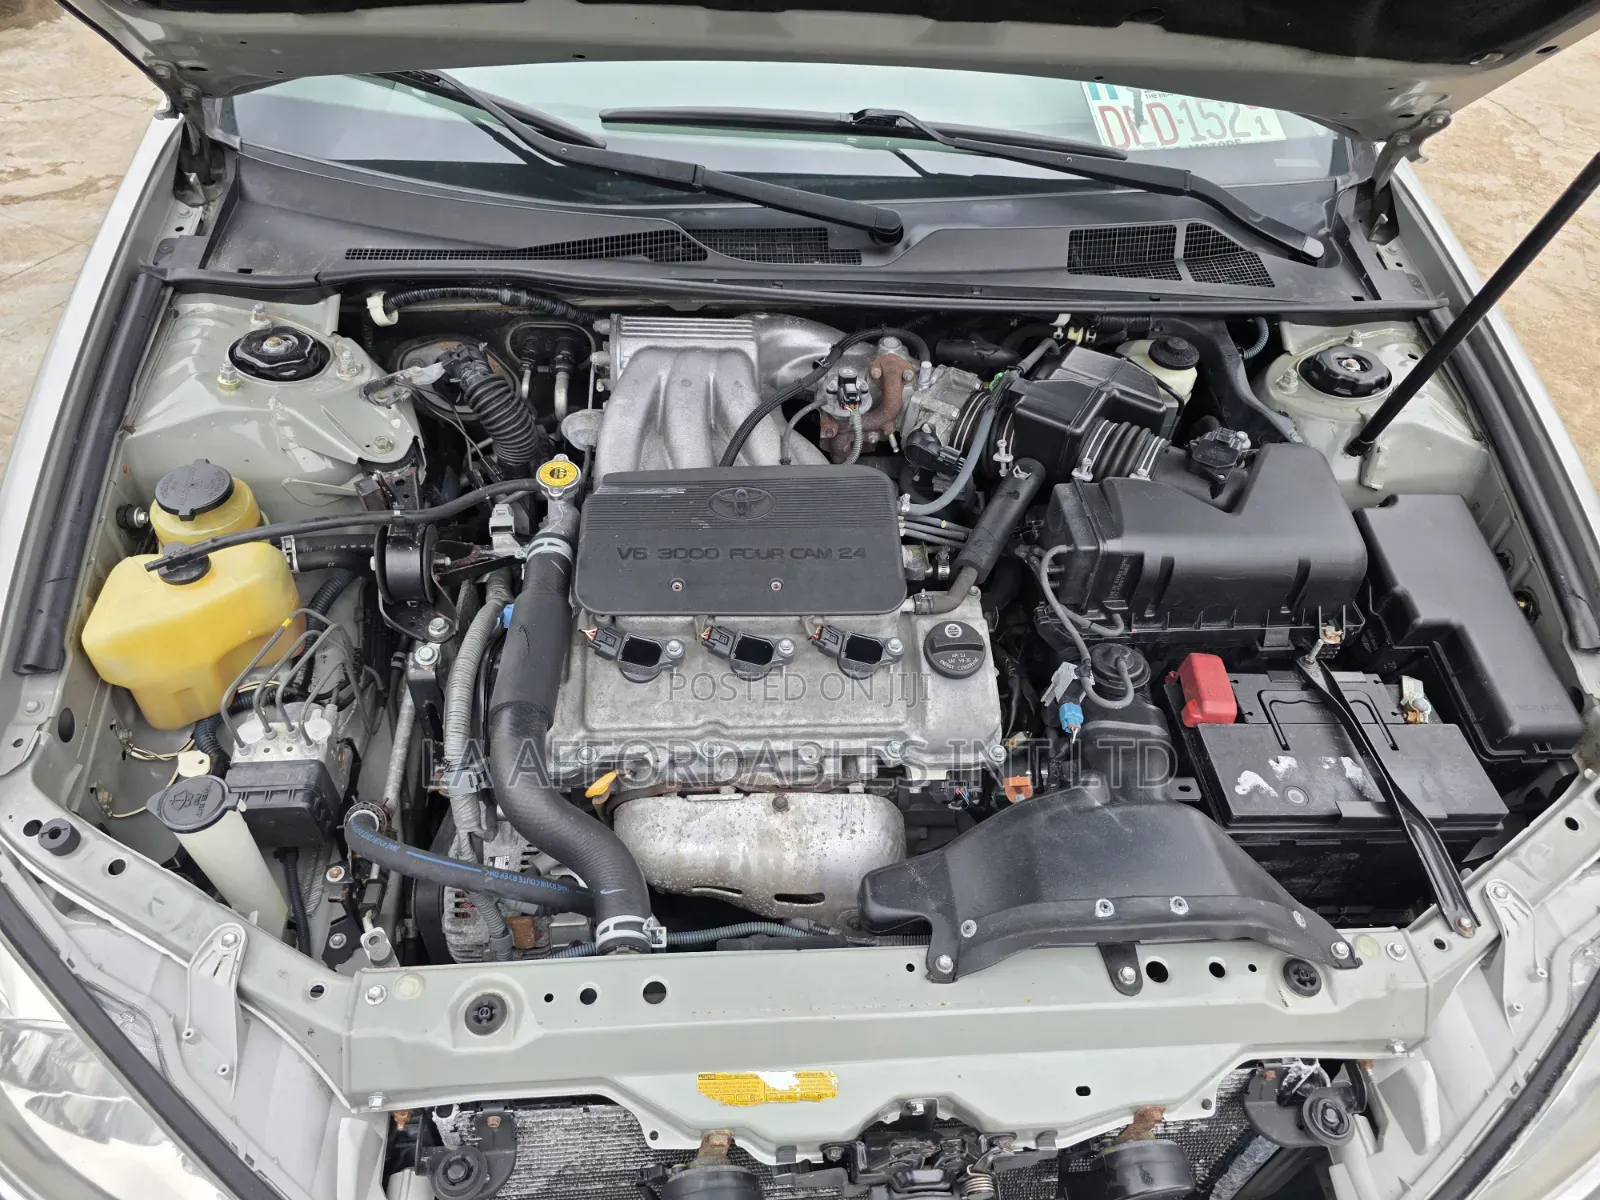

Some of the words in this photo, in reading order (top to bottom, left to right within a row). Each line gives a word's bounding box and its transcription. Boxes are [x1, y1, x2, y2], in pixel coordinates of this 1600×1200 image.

[616, 546, 648, 561] V6
[657, 546, 720, 561] 3000
[729, 546, 784, 560] FOUR
[790, 546, 833, 560] CAM
[838, 546, 867, 560] 24
